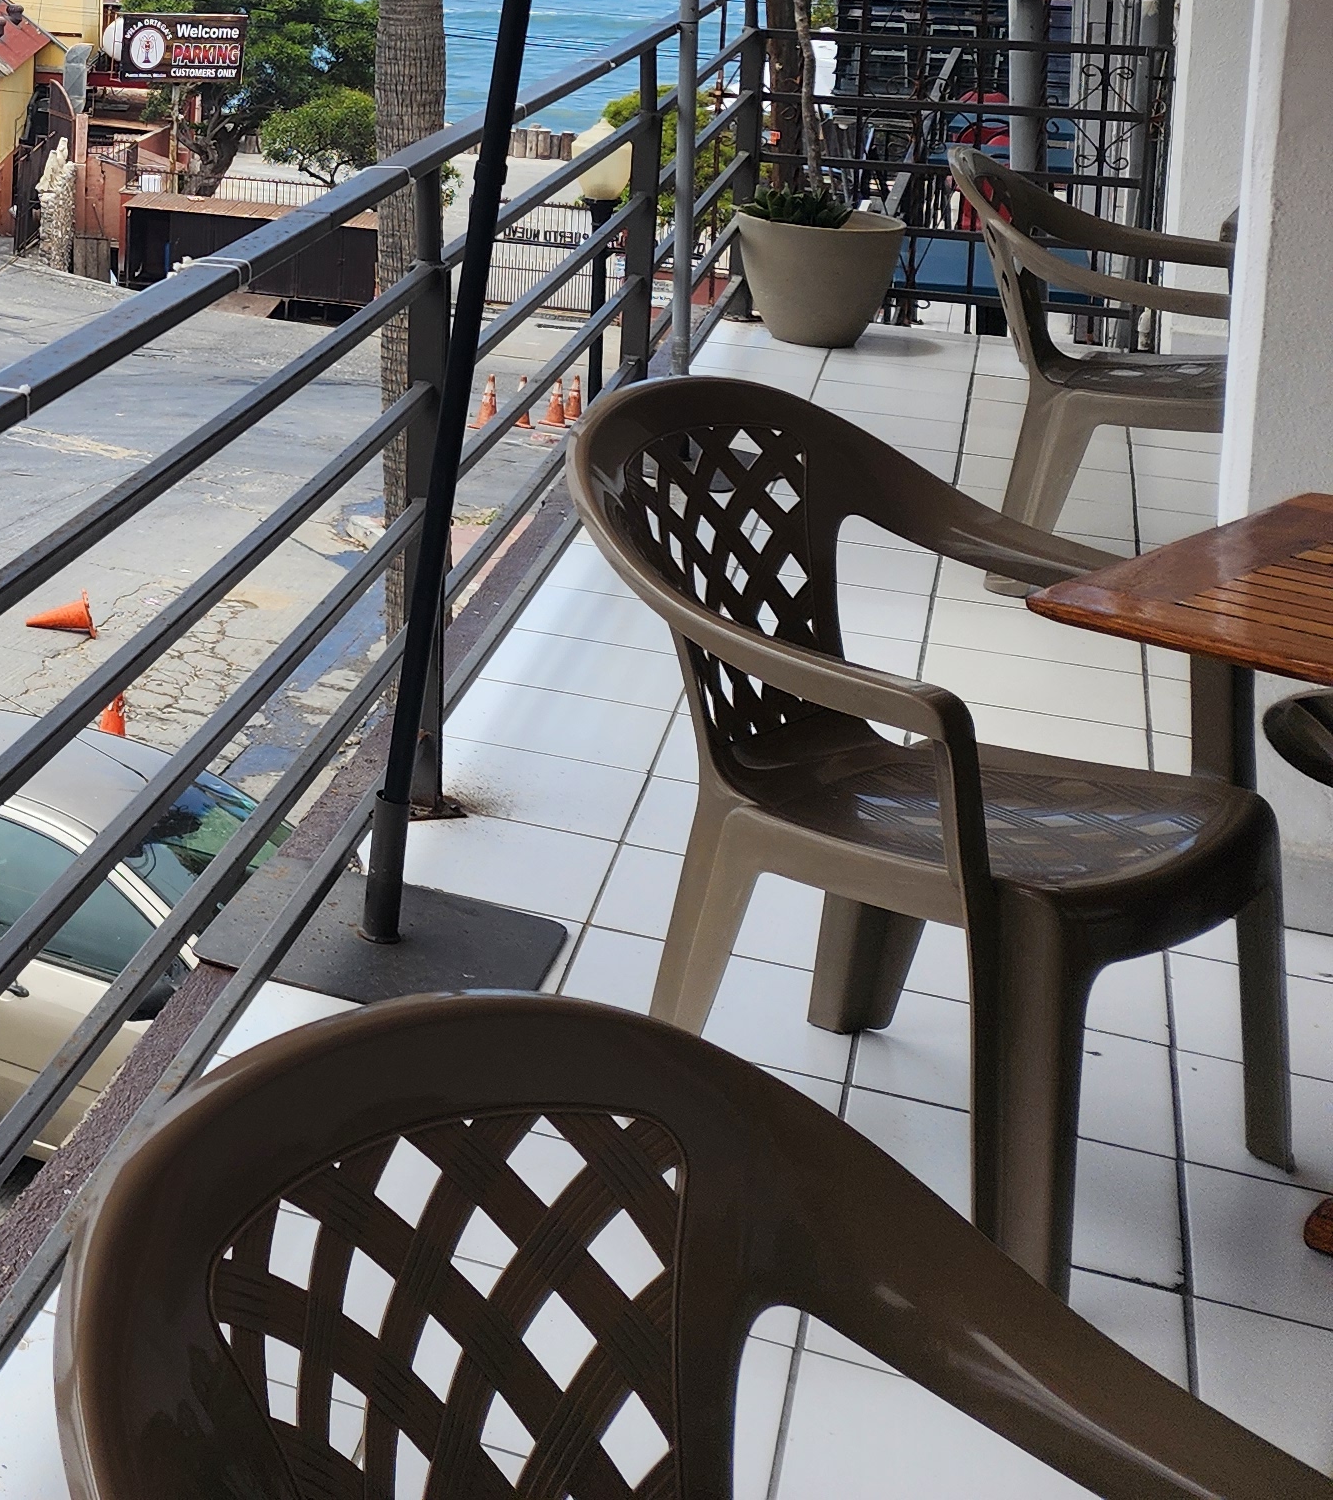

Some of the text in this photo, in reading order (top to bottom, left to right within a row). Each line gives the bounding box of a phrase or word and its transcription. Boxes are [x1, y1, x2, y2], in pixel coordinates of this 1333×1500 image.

[124, 21, 143, 39] VILLA
[176, 24, 240, 38] Welcome
[172, 43, 240, 66] PARKING
[170, 68, 216, 77] CUSTOMERS
[217, 68, 237, 77] ONLY
